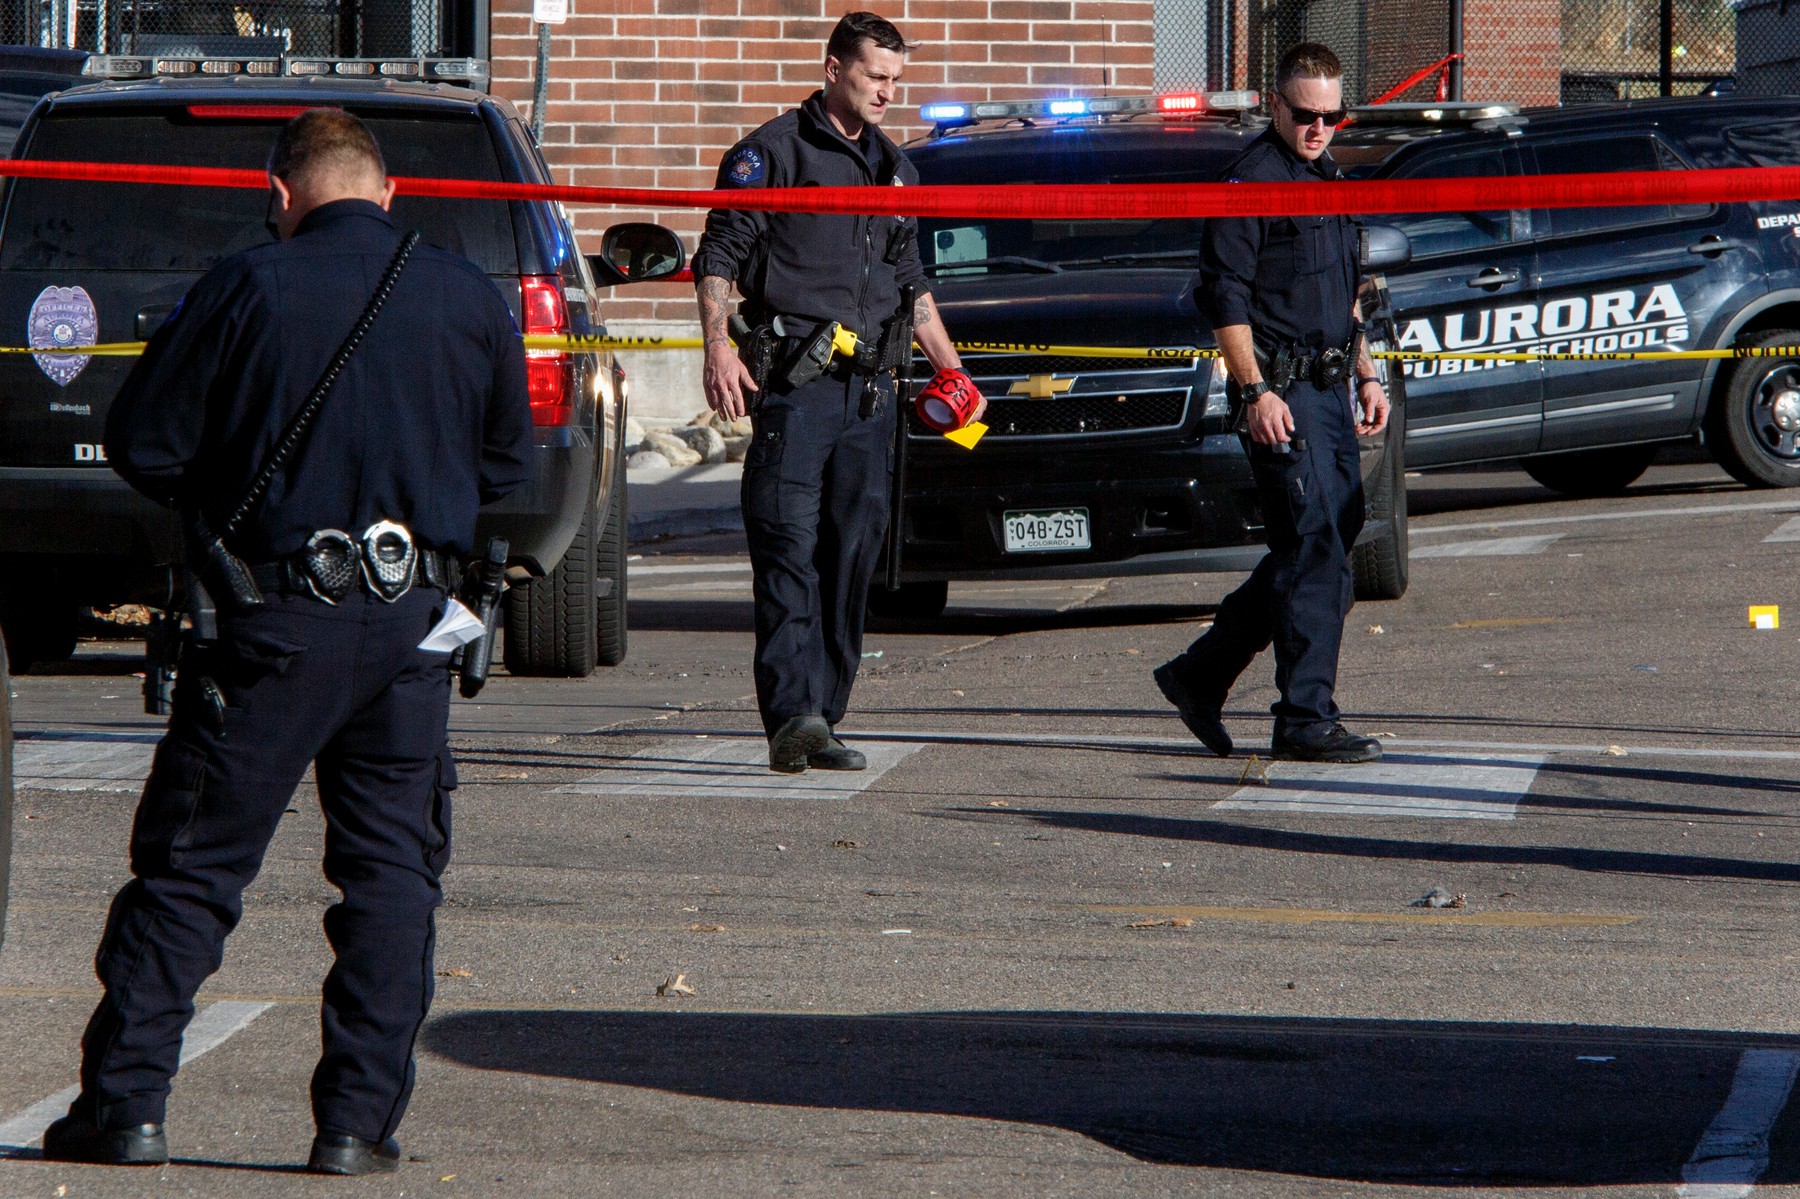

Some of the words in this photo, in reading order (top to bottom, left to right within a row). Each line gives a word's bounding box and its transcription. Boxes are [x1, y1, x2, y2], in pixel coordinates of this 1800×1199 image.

[43, 310, 85, 325] AURORA
[1400, 283, 1688, 353] AURORA
[1526, 325, 1689, 363] SCHOOLS
[1027, 539, 1069, 547] COLORADO
